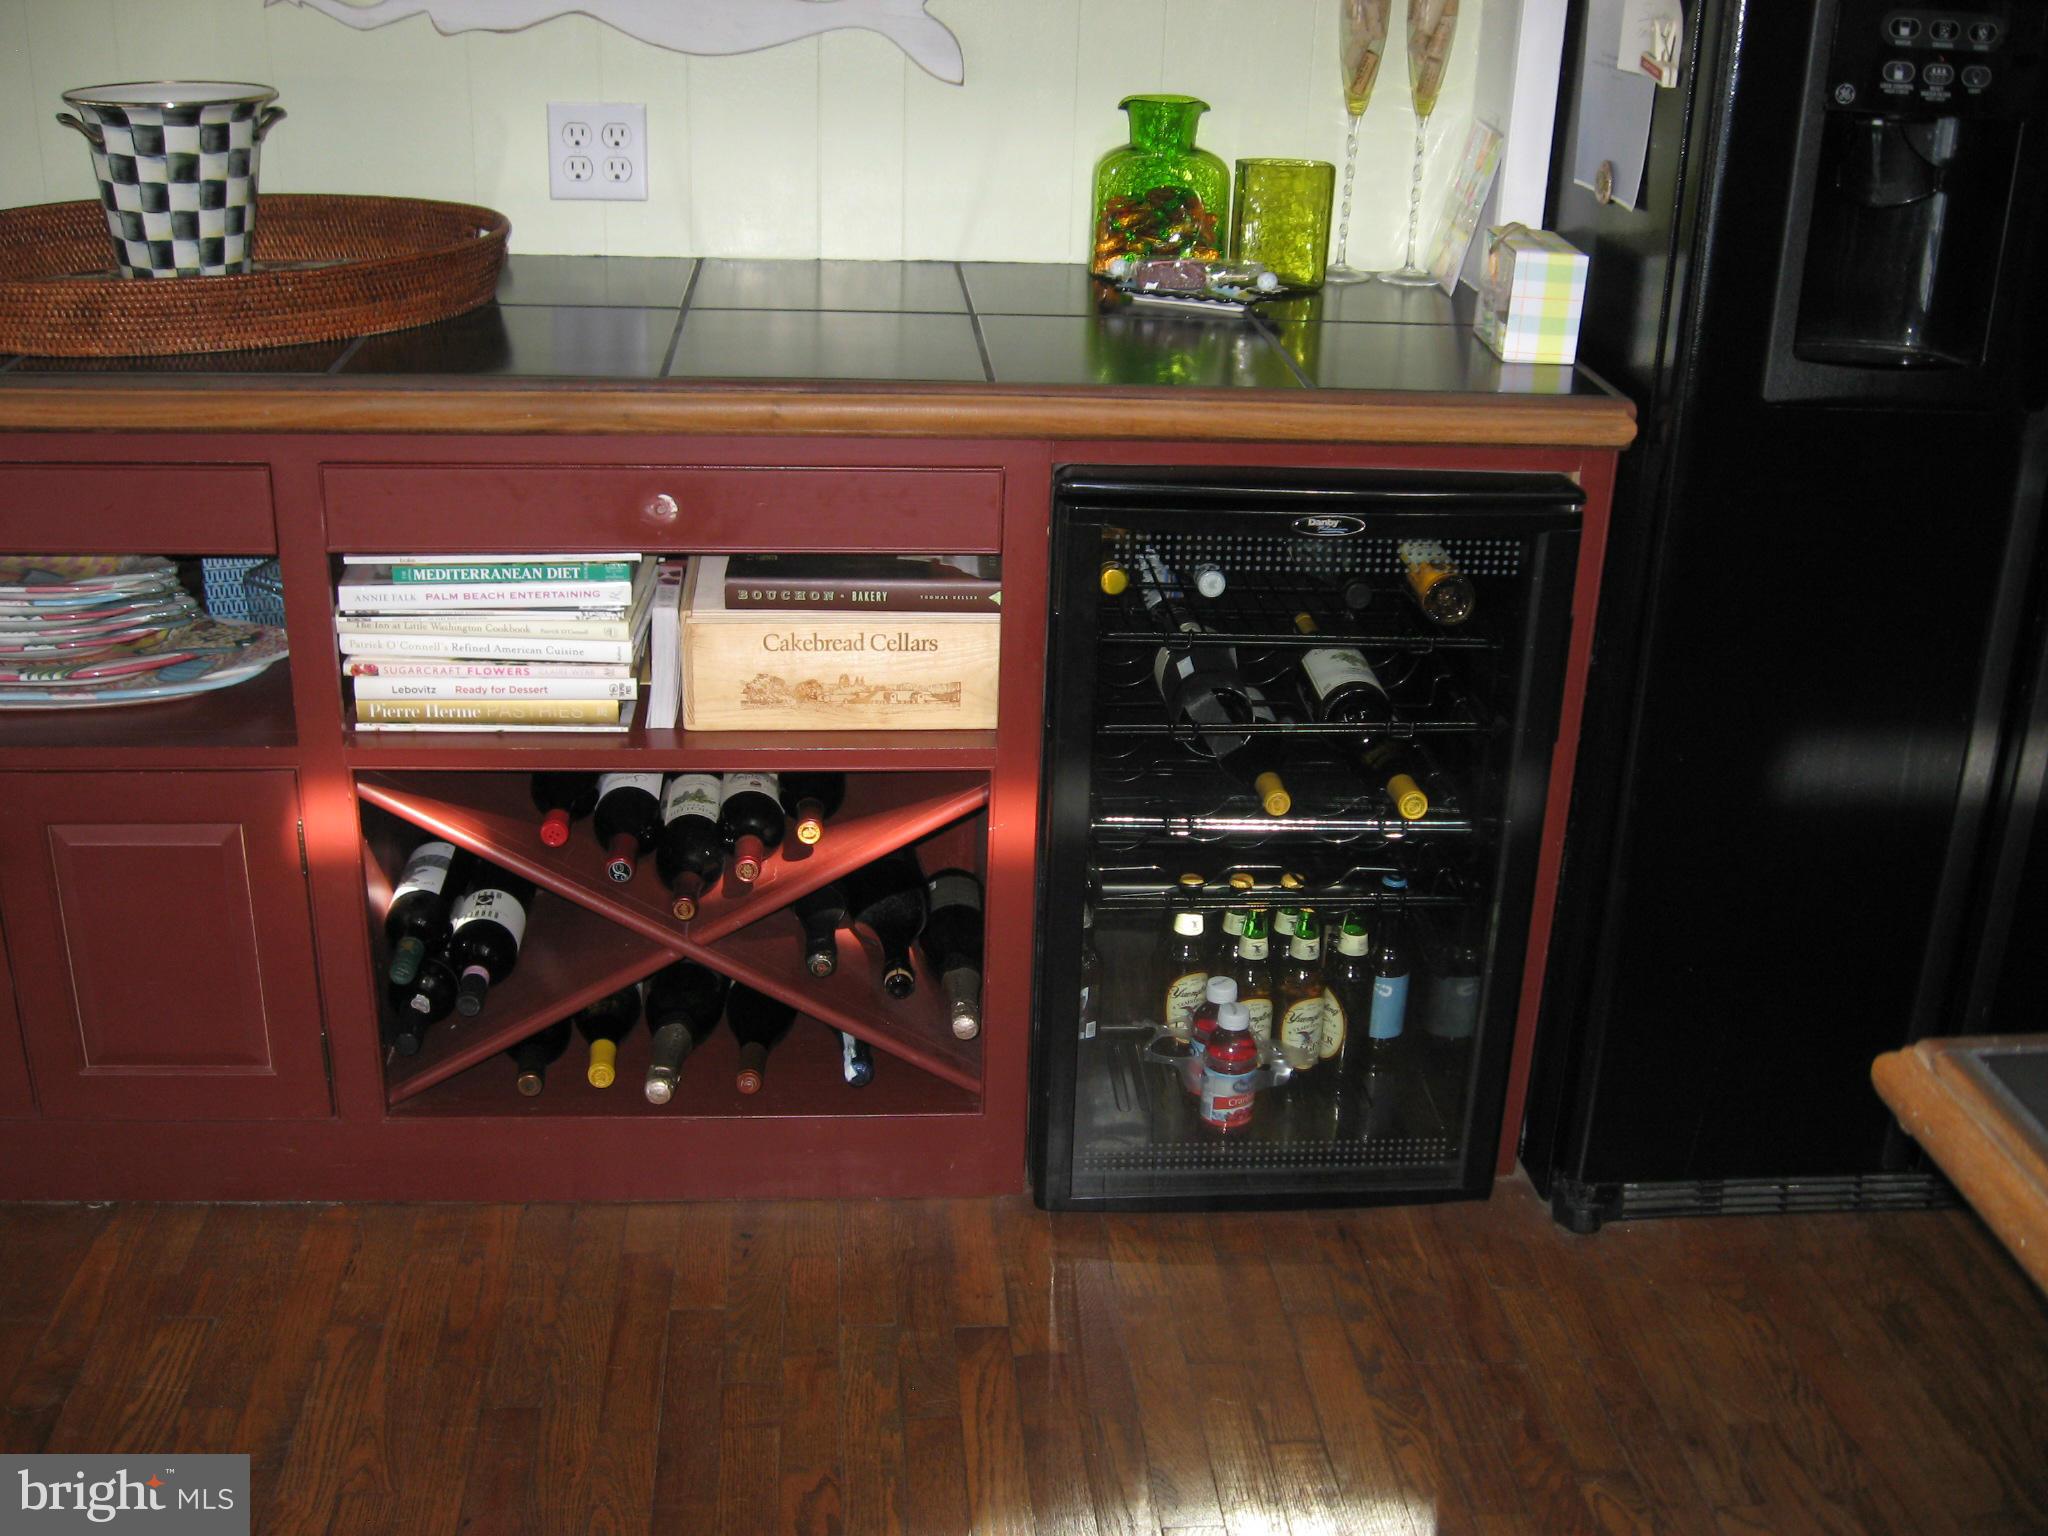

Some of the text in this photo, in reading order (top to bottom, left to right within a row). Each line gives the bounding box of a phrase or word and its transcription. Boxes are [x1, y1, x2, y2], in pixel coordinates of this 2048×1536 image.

[1308, 518, 1340, 528] Danby
[413, 567, 542, 581] MEDITERRANEAN
[547, 566, 580, 579] DIET
[355, 594, 387, 602] ANNIE
[425, 592, 459, 601] PALM
[463, 591, 506, 601] BEACH
[509, 589, 601, 600] ENTERTAINING
[737, 589, 835, 601] BOUCHON
[852, 590, 888, 602] BAKERY
[355, 622, 372, 630] The
[374, 622, 390, 630] Inn
[404, 622, 428, 632] Little
[431, 623, 483, 635] Washington
[485, 623, 531, 634] Cookbook
[349, 639, 382, 650] Patrick
[451, 642, 492, 654] Refined
[494, 644, 542, 655] American
[545, 645, 585, 657] Cuisine
[762, 632, 938, 652] Cakebread Cellars
[383, 666, 461, 676] SUGARCRAFT
[467, 667, 531, 676] FLOWERS
[391, 685, 549, 696] Lebovitz Ready for Dessert
[369, 703, 421, 719] Pierre
[487, 704, 584, 719] PASTRIES
